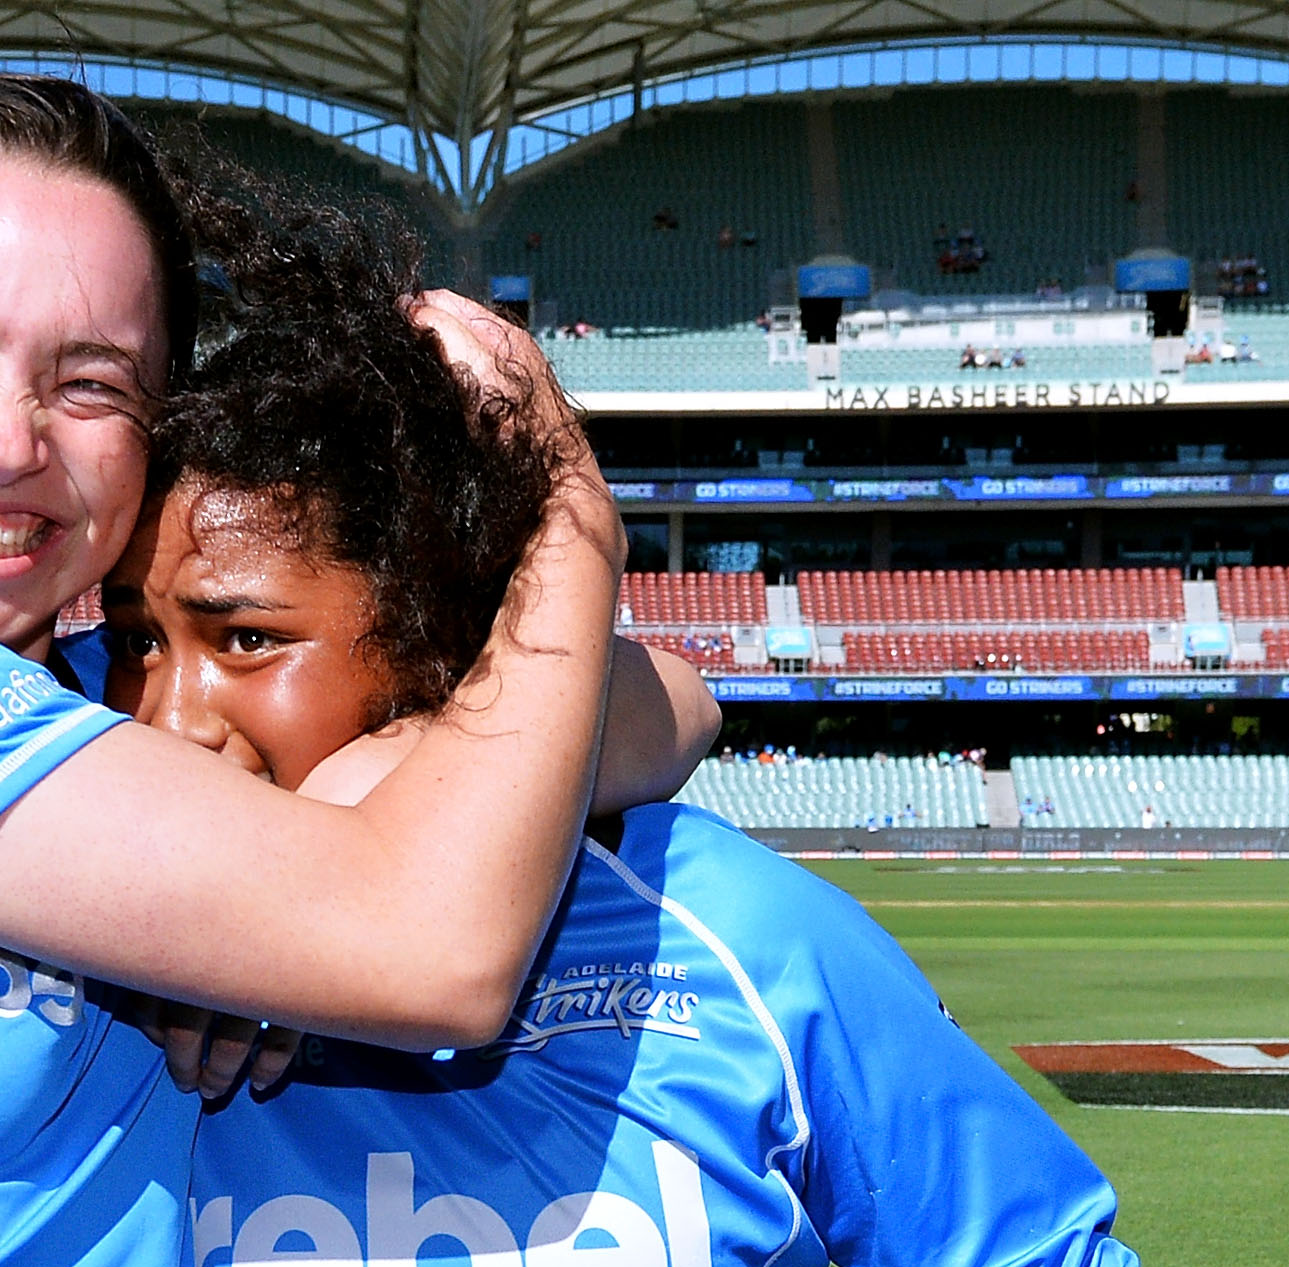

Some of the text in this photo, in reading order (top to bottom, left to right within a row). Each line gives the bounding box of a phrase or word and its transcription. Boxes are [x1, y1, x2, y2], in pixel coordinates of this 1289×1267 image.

[827, 381, 1170, 409] MAX BASHEER STAND
[696, 482, 717, 498] GO
[981, 480, 1003, 495] GO
[718, 681, 791, 696] STRIKERS
[834, 680, 943, 696] #STRIKEFORCE
[986, 680, 1008, 695] GO
[563, 961, 689, 982] ADELAIDE
[494, 974, 700, 1040] trikers
